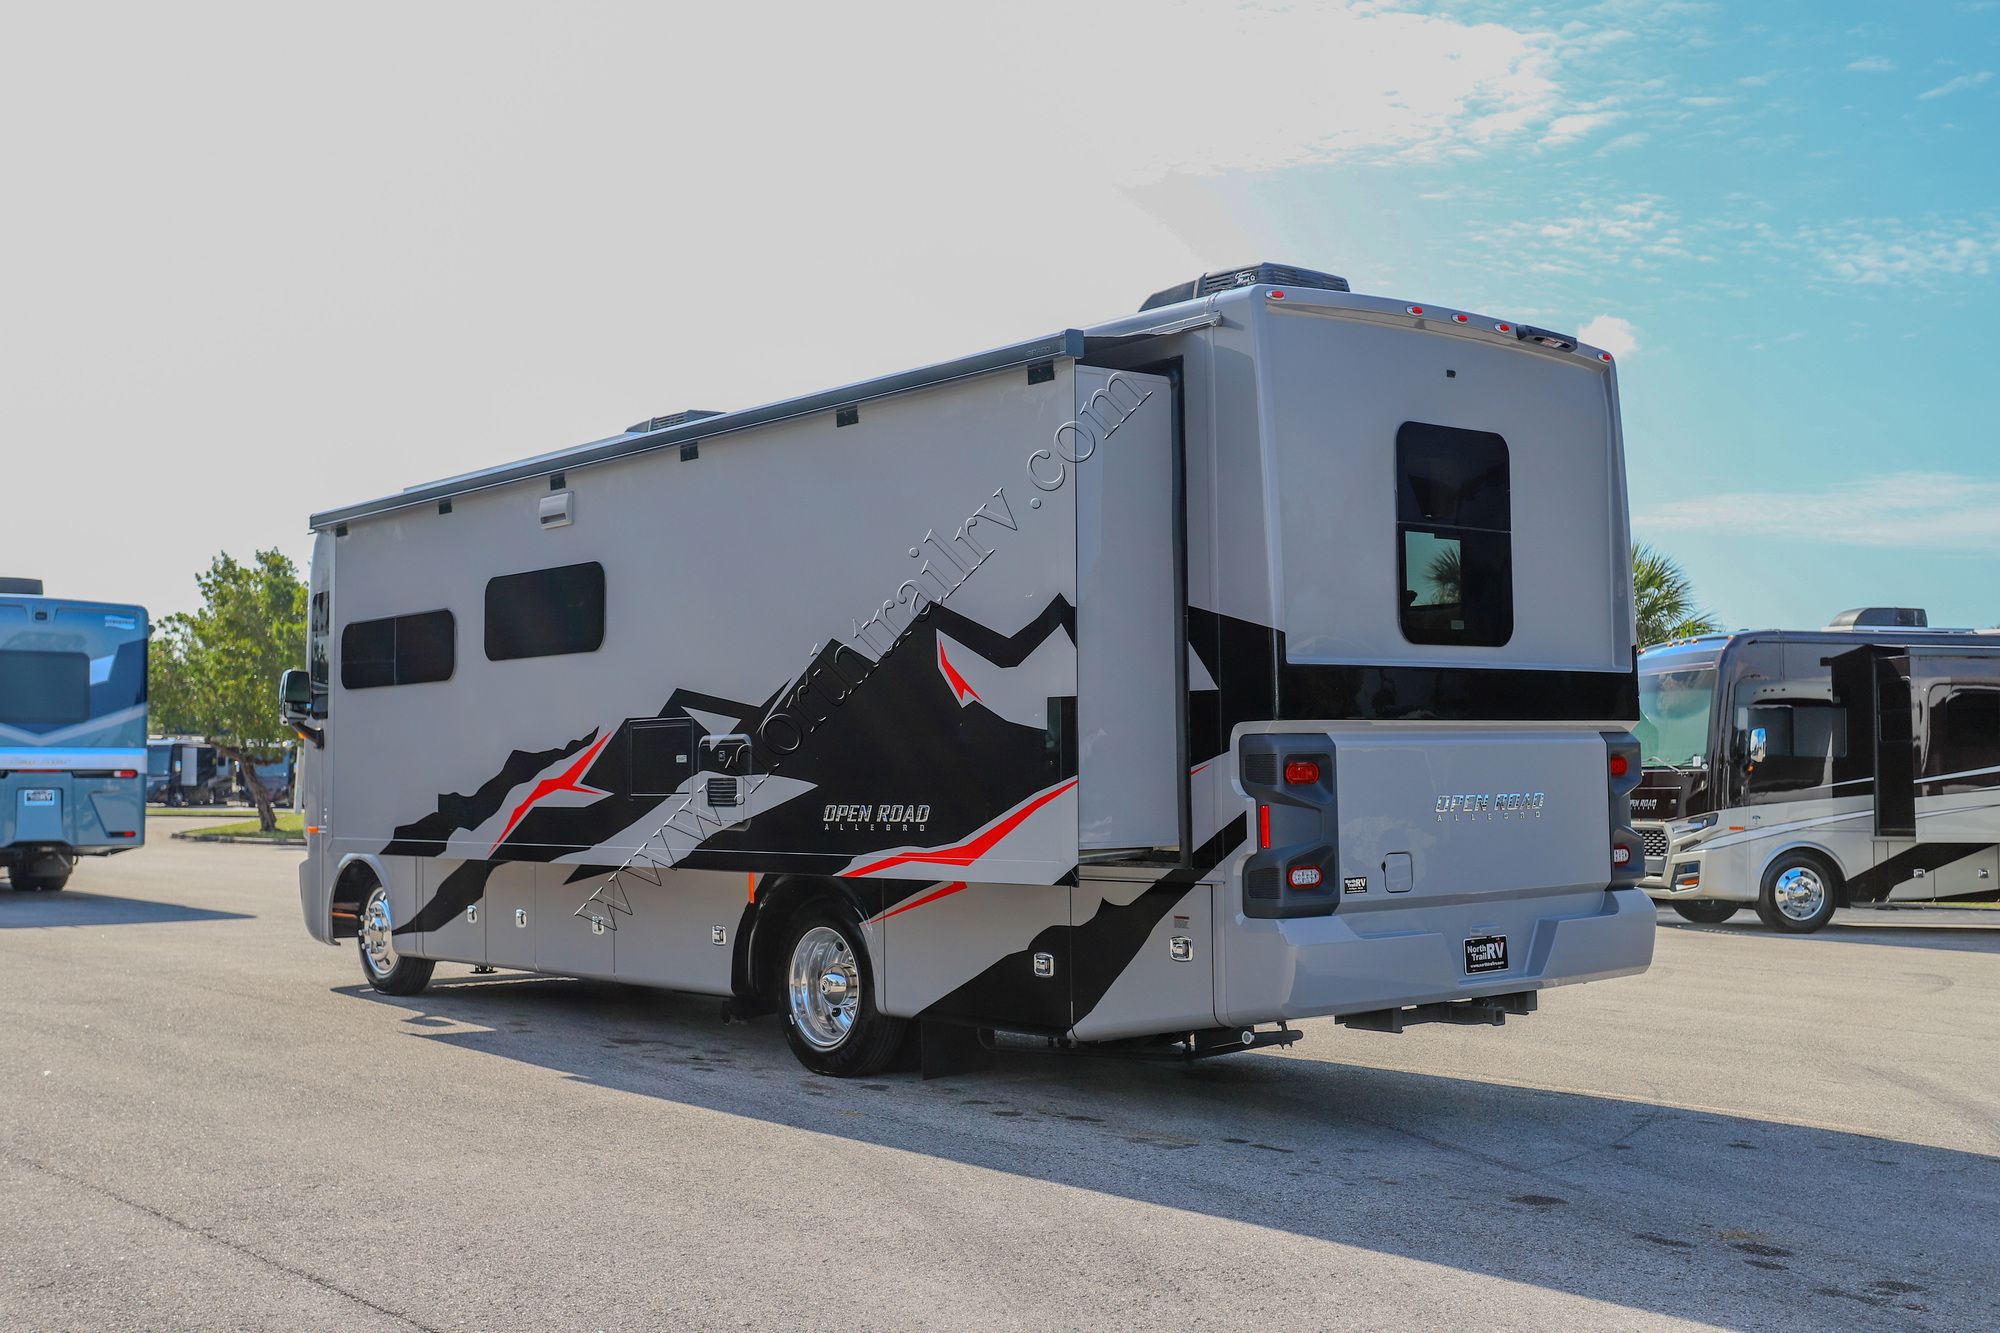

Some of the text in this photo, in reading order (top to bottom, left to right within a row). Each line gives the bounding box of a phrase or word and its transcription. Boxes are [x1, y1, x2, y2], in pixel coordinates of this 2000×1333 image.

[1434, 791, 1545, 813] OPEN ROAD
[823, 804, 930, 823] OPEN ROAD
[1436, 810, 1541, 822] ALLEGRO
[824, 823, 925, 832] ALLEGRO
[1355, 878, 1366, 887] RV
[1467, 944, 1487, 954] North
[1486, 941, 1505, 960] RV
[1471, 952, 1487, 962] Trail
